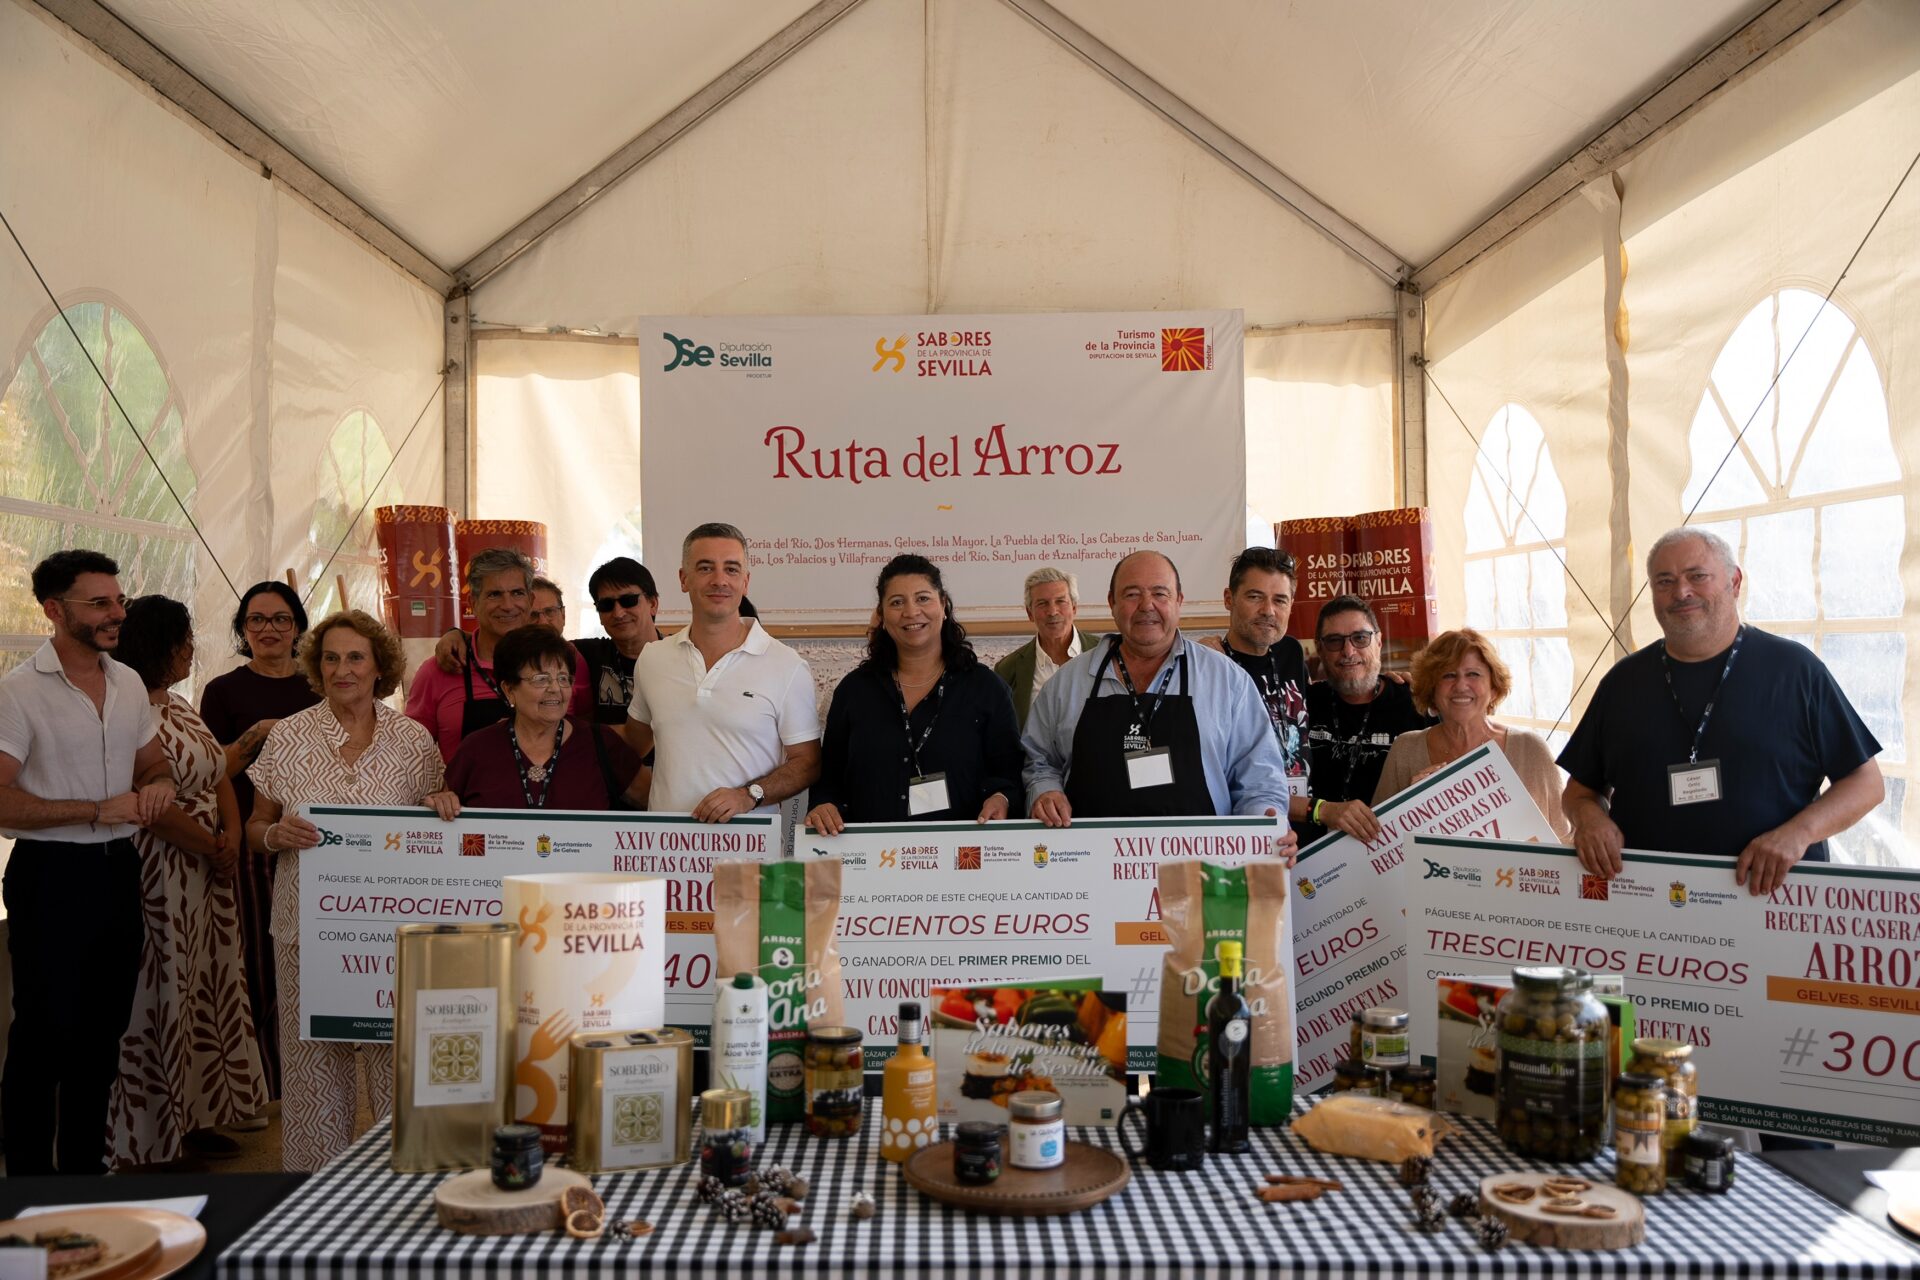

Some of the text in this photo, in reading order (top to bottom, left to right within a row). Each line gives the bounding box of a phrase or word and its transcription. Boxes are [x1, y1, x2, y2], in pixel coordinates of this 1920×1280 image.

[917, 331, 992, 346] SABORES
[1118, 330, 1155, 339] Turismo
[720, 342, 772, 353] Diputación
[917, 349, 927, 357] DE
[929, 349, 938, 357] LA
[940, 348, 980, 357] PROVINCIA
[1085, 341, 1155, 350] de la Provincia
[720, 353, 772, 367] Sevilla
[917, 360, 992, 376] SEVILLA
[764, 424, 1122, 484] Ruta del Arroz
[774, 538, 789, 549] del
[815, 537, 835, 549] Dos
[932, 536, 949, 547] Isla
[990, 535, 1002, 548] La
[1003, 534, 1038, 546] Puebla
[1041, 534, 1055, 545] del
[1081, 533, 1097, 546] Las
[1100, 532, 1140, 543] Cabezas
[1142, 532, 1154, 542] de
[1156, 531, 1175, 542] San
[767, 553, 784, 566] Los
[786, 553, 827, 564] Palacios
[952, 551, 966, 562] del
[992, 551, 1012, 561] San
[1012, 549, 1036, 563] Juan
[1038, 549, 1050, 560] de
[1052, 548, 1117, 562] Aznalfarache
[1359, 548, 1411, 566] SABORES
[1308, 571, 1328, 580] DE LA
[1402, 566, 1411, 574] DE
[1361, 577, 1413, 597] SEVILLA
[1399, 764, 1501, 832] CONCURSO DE
[1488, 786, 1512, 809] DE
[788, 798, 799, 848] PORTADOR
[345, 839, 372, 847] Sevilla
[406, 831, 443, 840] SABORES
[614, 831, 766, 852] XXIV CONCURSO DE
[406, 845, 443, 854] SEVILLA
[901, 847, 938, 855] SABORES
[1113, 835, 1273, 857] XXIV CONCURSO DE
[613, 855, 676, 873] RECETAS
[901, 861, 938, 870] SEVILLA
[1313, 862, 1347, 884] Ayuntamiento
[318, 873, 470, 887] PÁGUESE AL PORTADOR DE ESTE
[1453, 872, 1481, 881] Sevilla
[1519, 867, 1560, 880] SABORES
[1519, 883, 1560, 895] SEVILLA
[1628, 884, 1655, 892] Provincia
[1689, 890, 1738, 900] Ayuntamiento
[320, 895, 503, 917] CUATROCIENTO
[858, 892, 1089, 903] AL PORTADOR DE ESTE CHEQUE LA CANTIDAD DE
[1699, 897, 1722, 905] Gelves
[1767, 884, 1920, 915] XXIV CONCURS
[564, 900, 645, 919] SABORES
[1301, 897, 1368, 939] LA CANTIDAD DE
[563, 919, 644, 931] DE LA PROVINCIA DE
[836, 913, 1090, 936] EISCIENTOS EUROS
[1425, 907, 1736, 948] PÁGUESE AL PORTADOR DE ESTE CHEQUE LA CANTIDAD DE
[1765, 910, 1846, 936] RECETAS
[318, 931, 356, 942] COMO
[762, 935, 802, 944] ARROZ
[1206, 929, 1244, 938] ARROZ
[563, 933, 644, 954] SEVILLA
[1296, 918, 1378, 977] EUROS
[341, 955, 381, 974] XXIV
[852, 954, 1092, 967] GANADOR/A DEL PRIMER PREMIO DEL
[1427, 930, 1749, 985] TRESCIENTOS EUROS
[1345, 956, 1390, 985] PREMIO
[1797, 988, 1863, 1006] GELVES.
[425, 1004, 488, 1017] SOBERBIO
[1308, 978, 1398, 1038] DE RECETAS
[1651, 997, 1744, 1017] PREMIO DEL
[968, 1017, 1070, 1043] Sabores
[964, 1042, 1100, 1060] de la provincia
[609, 1063, 669, 1077] SOBERBIO
[1004, 1058, 1108, 1076] de Sevilla
[1309, 1053, 1335, 1077] DE
[1731, 1105, 1895, 1135] PUEBLA DEL LAS CABEZAS SAN
[1741, 1116, 1889, 1144] JUAN AZNALFARACHE UTRERA
